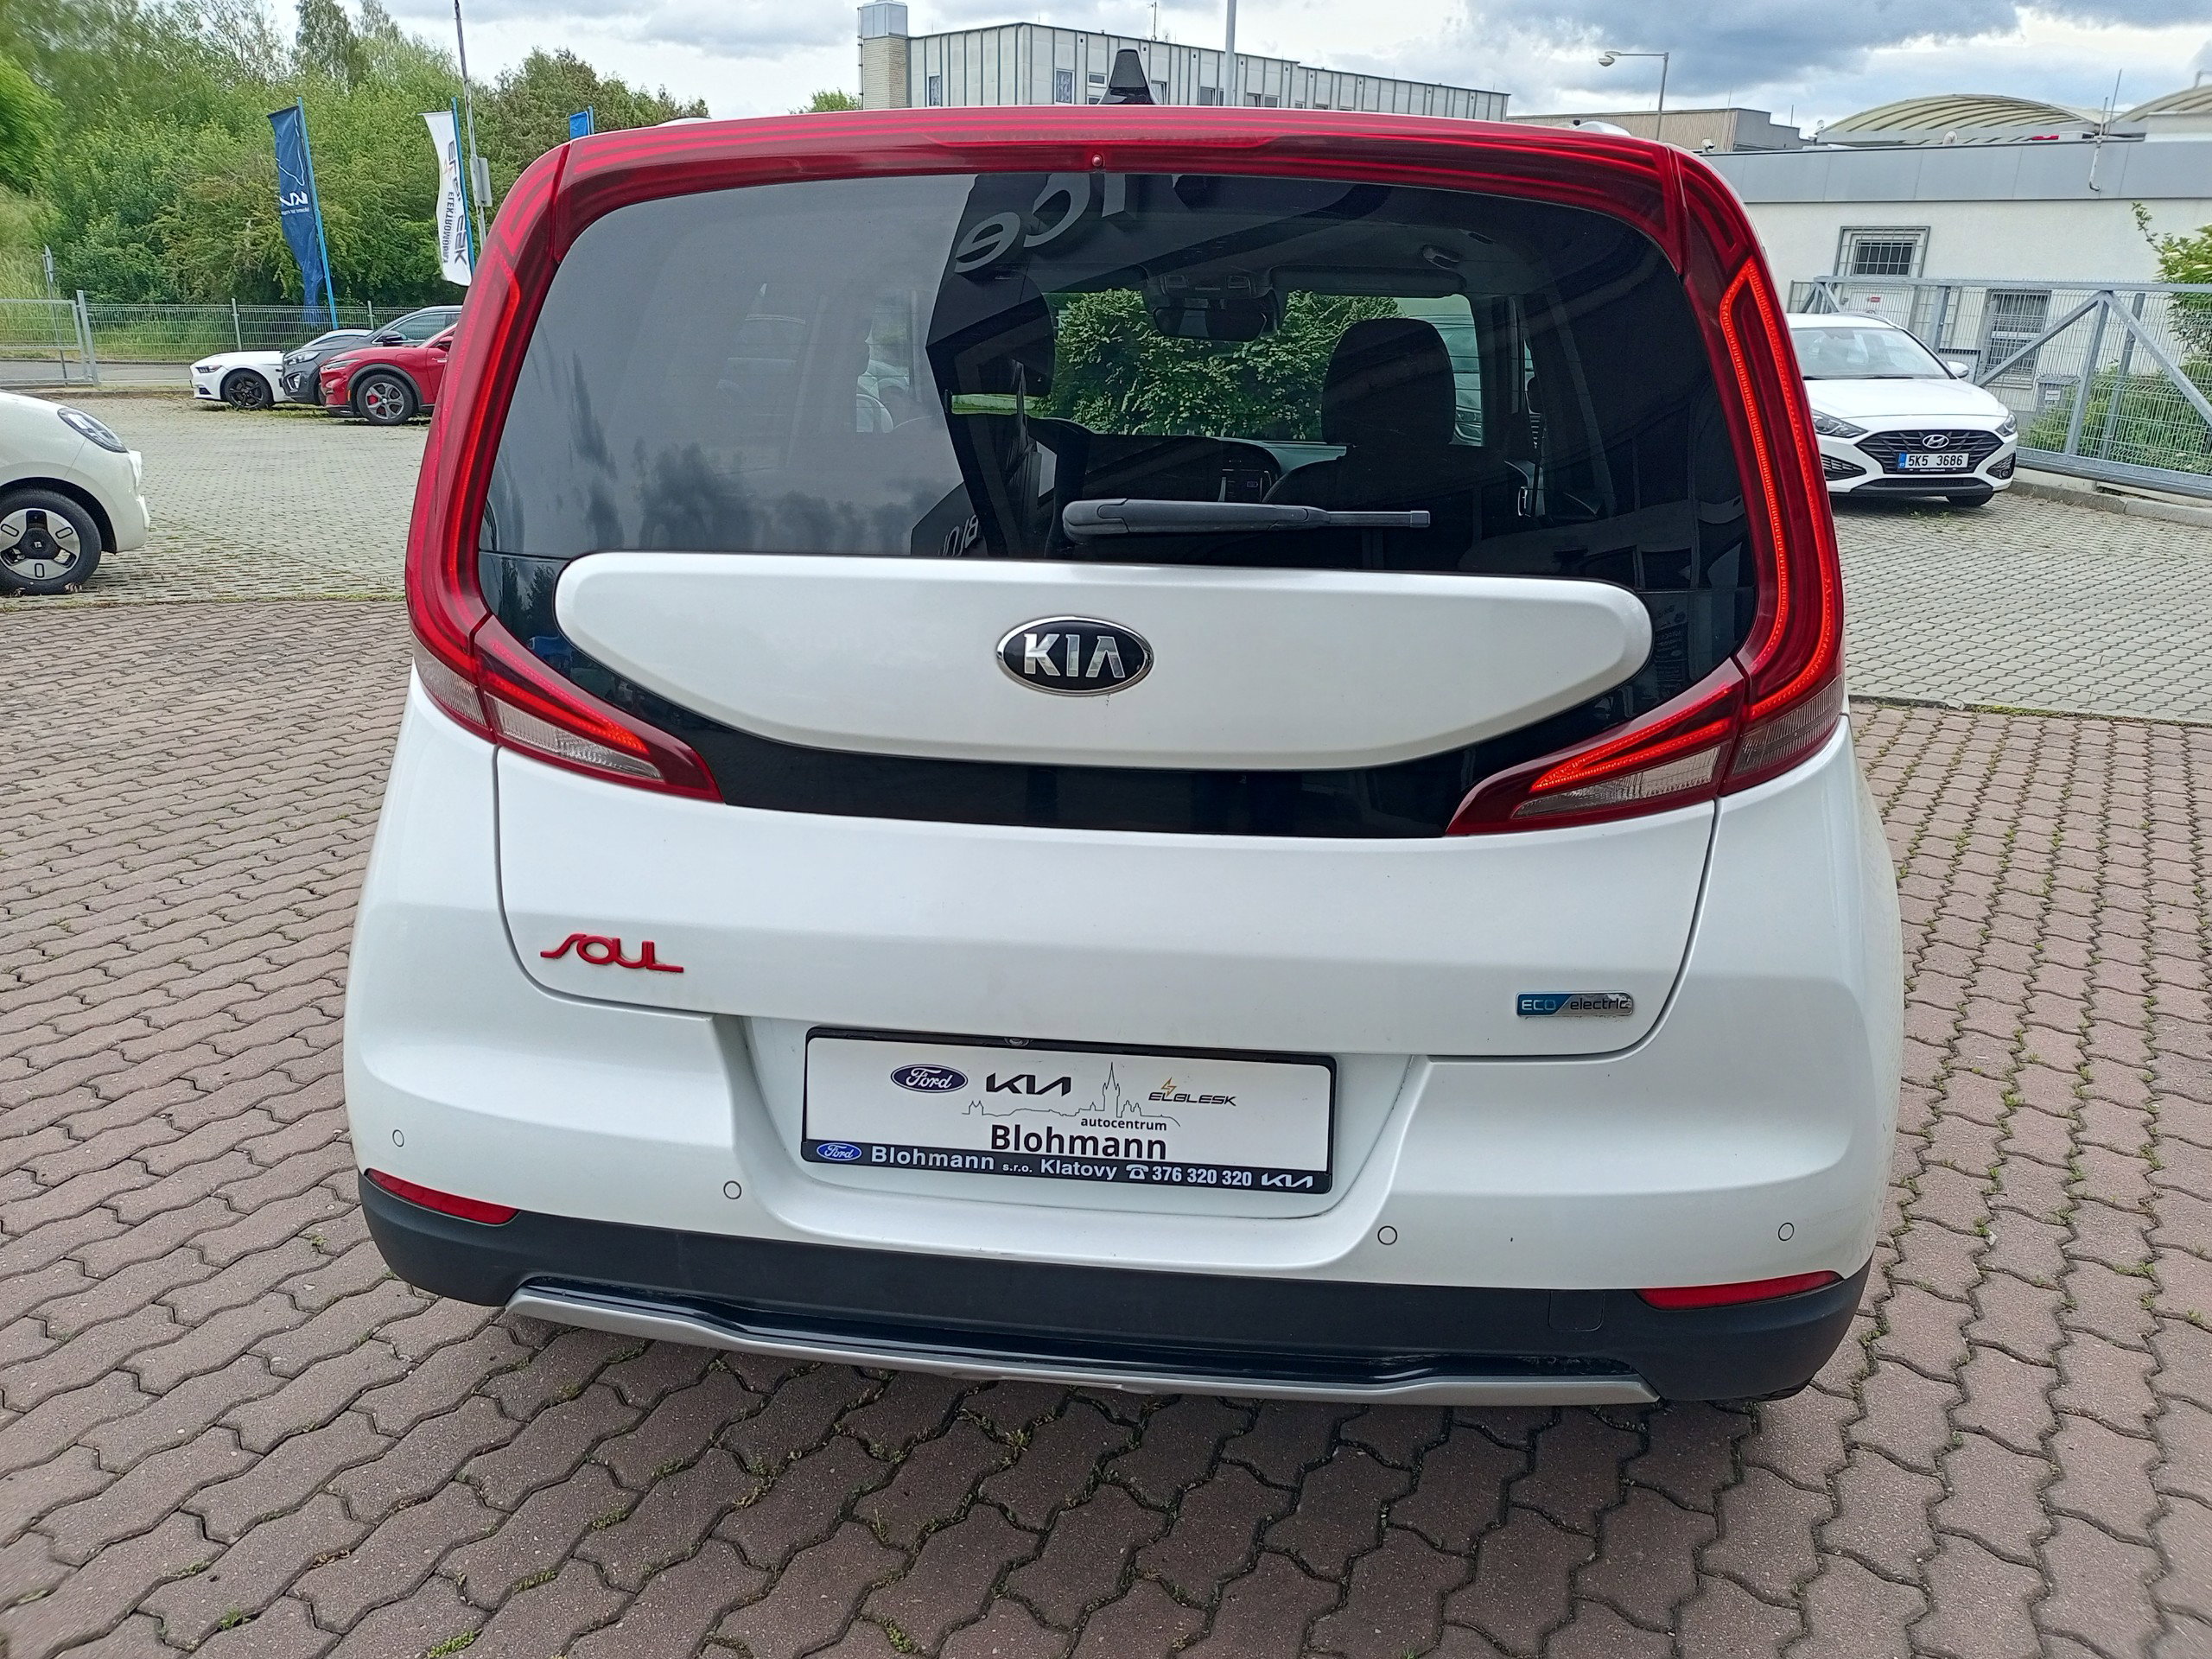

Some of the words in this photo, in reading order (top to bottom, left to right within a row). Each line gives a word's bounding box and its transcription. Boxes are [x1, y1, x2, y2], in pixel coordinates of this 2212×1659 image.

[1908, 455, 1929, 466] 5K5
[1936, 454, 1963, 466] 3686
[1023, 633, 1126, 678] KIA
[540, 933, 684, 973] SOUL
[1522, 999, 1556, 1011] ECO
[1570, 997, 1630, 1011] electric
[906, 1066, 953, 1089] Ford
[986, 1072, 1071, 1096] KIA
[1148, 1091, 1236, 1106] ELBLESK
[1080, 1116, 1166, 1131] autocentrum
[991, 1124, 1166, 1160] Blohmann
[823, 1143, 855, 1159] Ford
[871, 1146, 995, 1170] Blohmann
[1002, 1163, 1033, 1173] s.r.o.
[1040, 1159, 1117, 1180] Klatovy
[1152, 1166, 1182, 1182] 376
[1187, 1167, 1217, 1184] 320
[1222, 1170, 1252, 1186] 320
[1261, 1172, 1313, 1189] KIA
